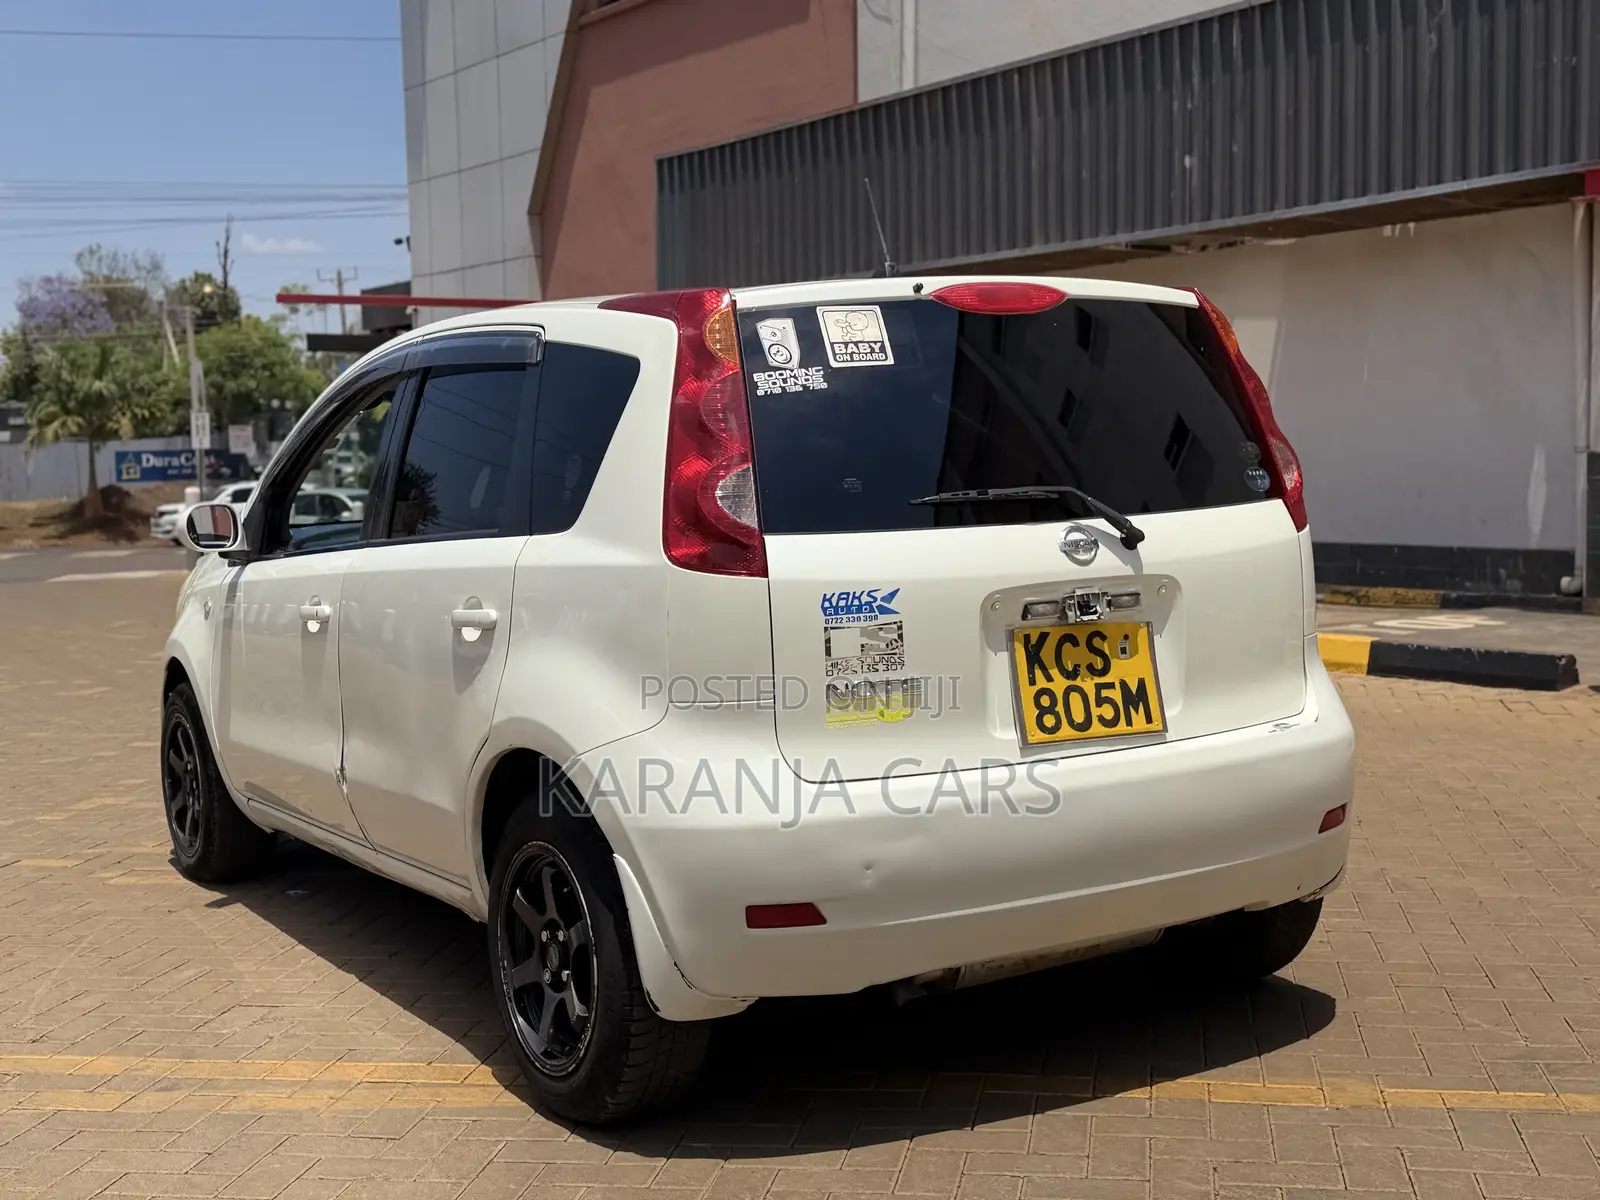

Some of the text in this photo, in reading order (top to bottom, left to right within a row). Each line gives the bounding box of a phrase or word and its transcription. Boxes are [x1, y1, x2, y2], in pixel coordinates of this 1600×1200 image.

[833, 342, 882, 354] BABY
[836, 352, 886, 362] ON BOARD
[752, 366, 824, 382] BOOMING
[756, 387, 782, 396] 0710
[806, 381, 828, 390] 750
[757, 374, 824, 390] SOUNDS
[821, 588, 882, 607] KAKS
[826, 605, 870, 616] AUTO
[824, 616, 844, 626] 0722
[845, 615, 861, 624] 330
[1023, 630, 1112, 686] KCS
[882, 662, 905, 672] 307
[1033, 677, 1153, 735] 805M
